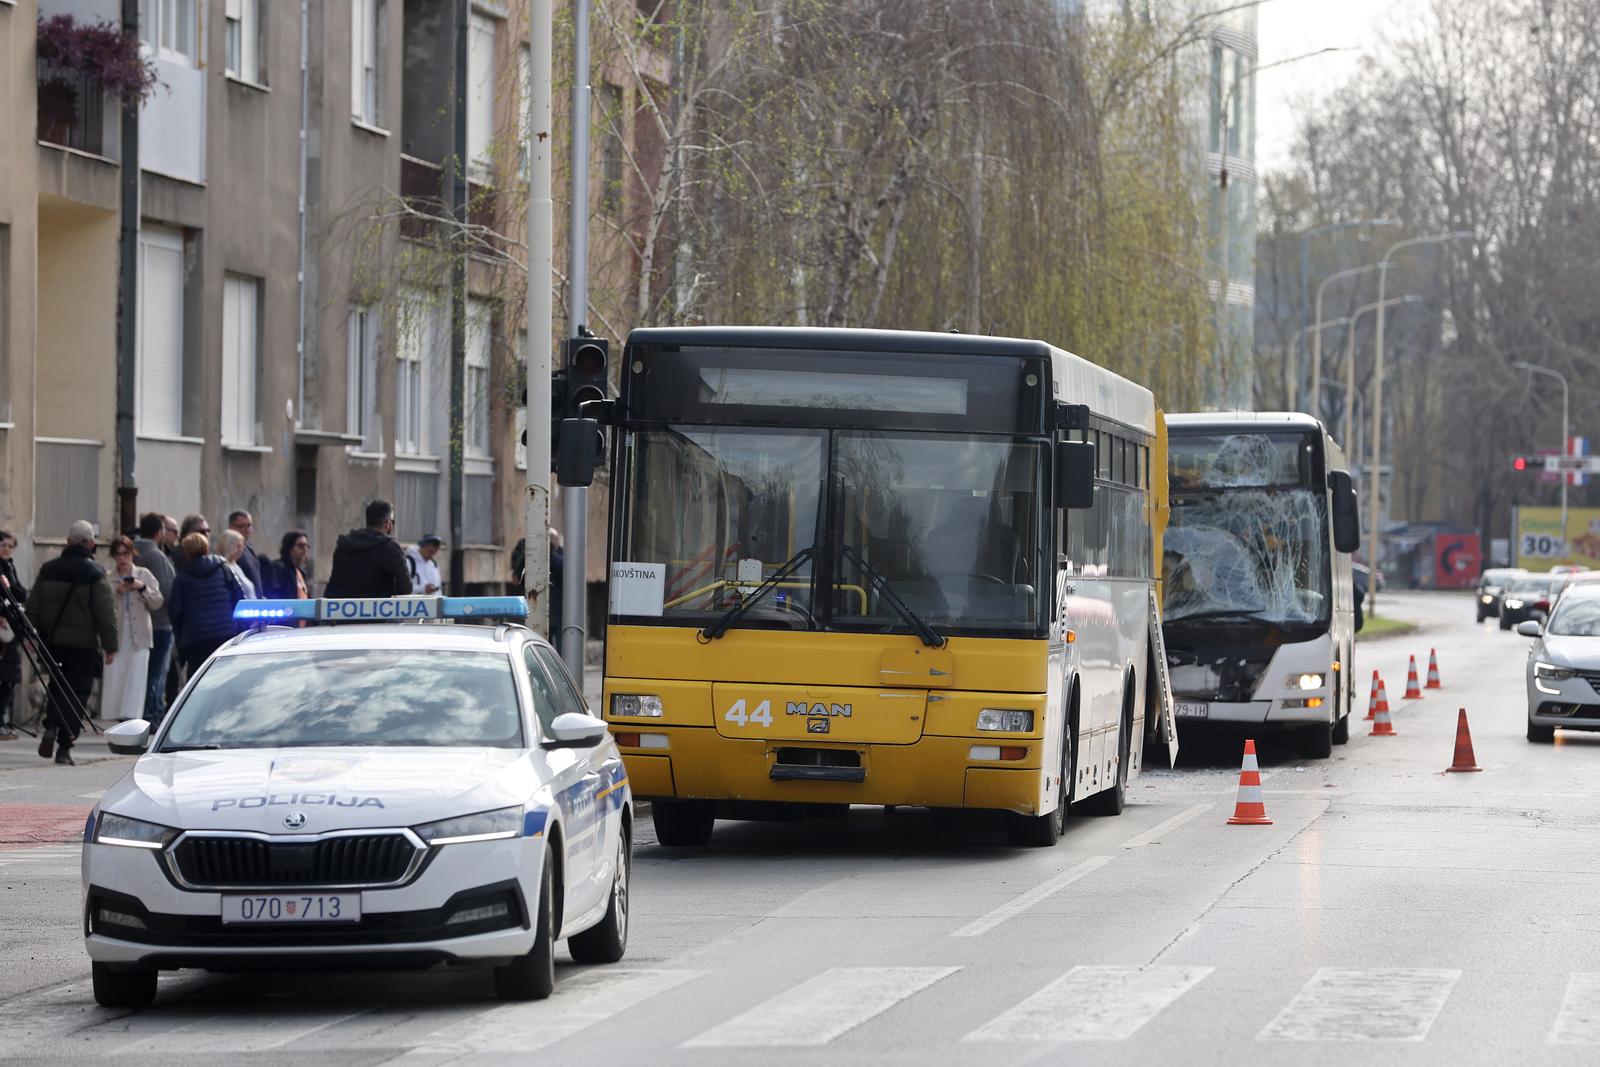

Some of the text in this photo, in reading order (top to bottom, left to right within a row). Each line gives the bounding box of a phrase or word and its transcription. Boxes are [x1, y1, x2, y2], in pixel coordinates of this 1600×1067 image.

[326, 600, 429, 618] POLICIJA
[725, 699, 773, 728] 44
[786, 702, 852, 717] MAN
[211, 793, 385, 811] POLICIJA
[241, 897, 341, 919] 070 713
